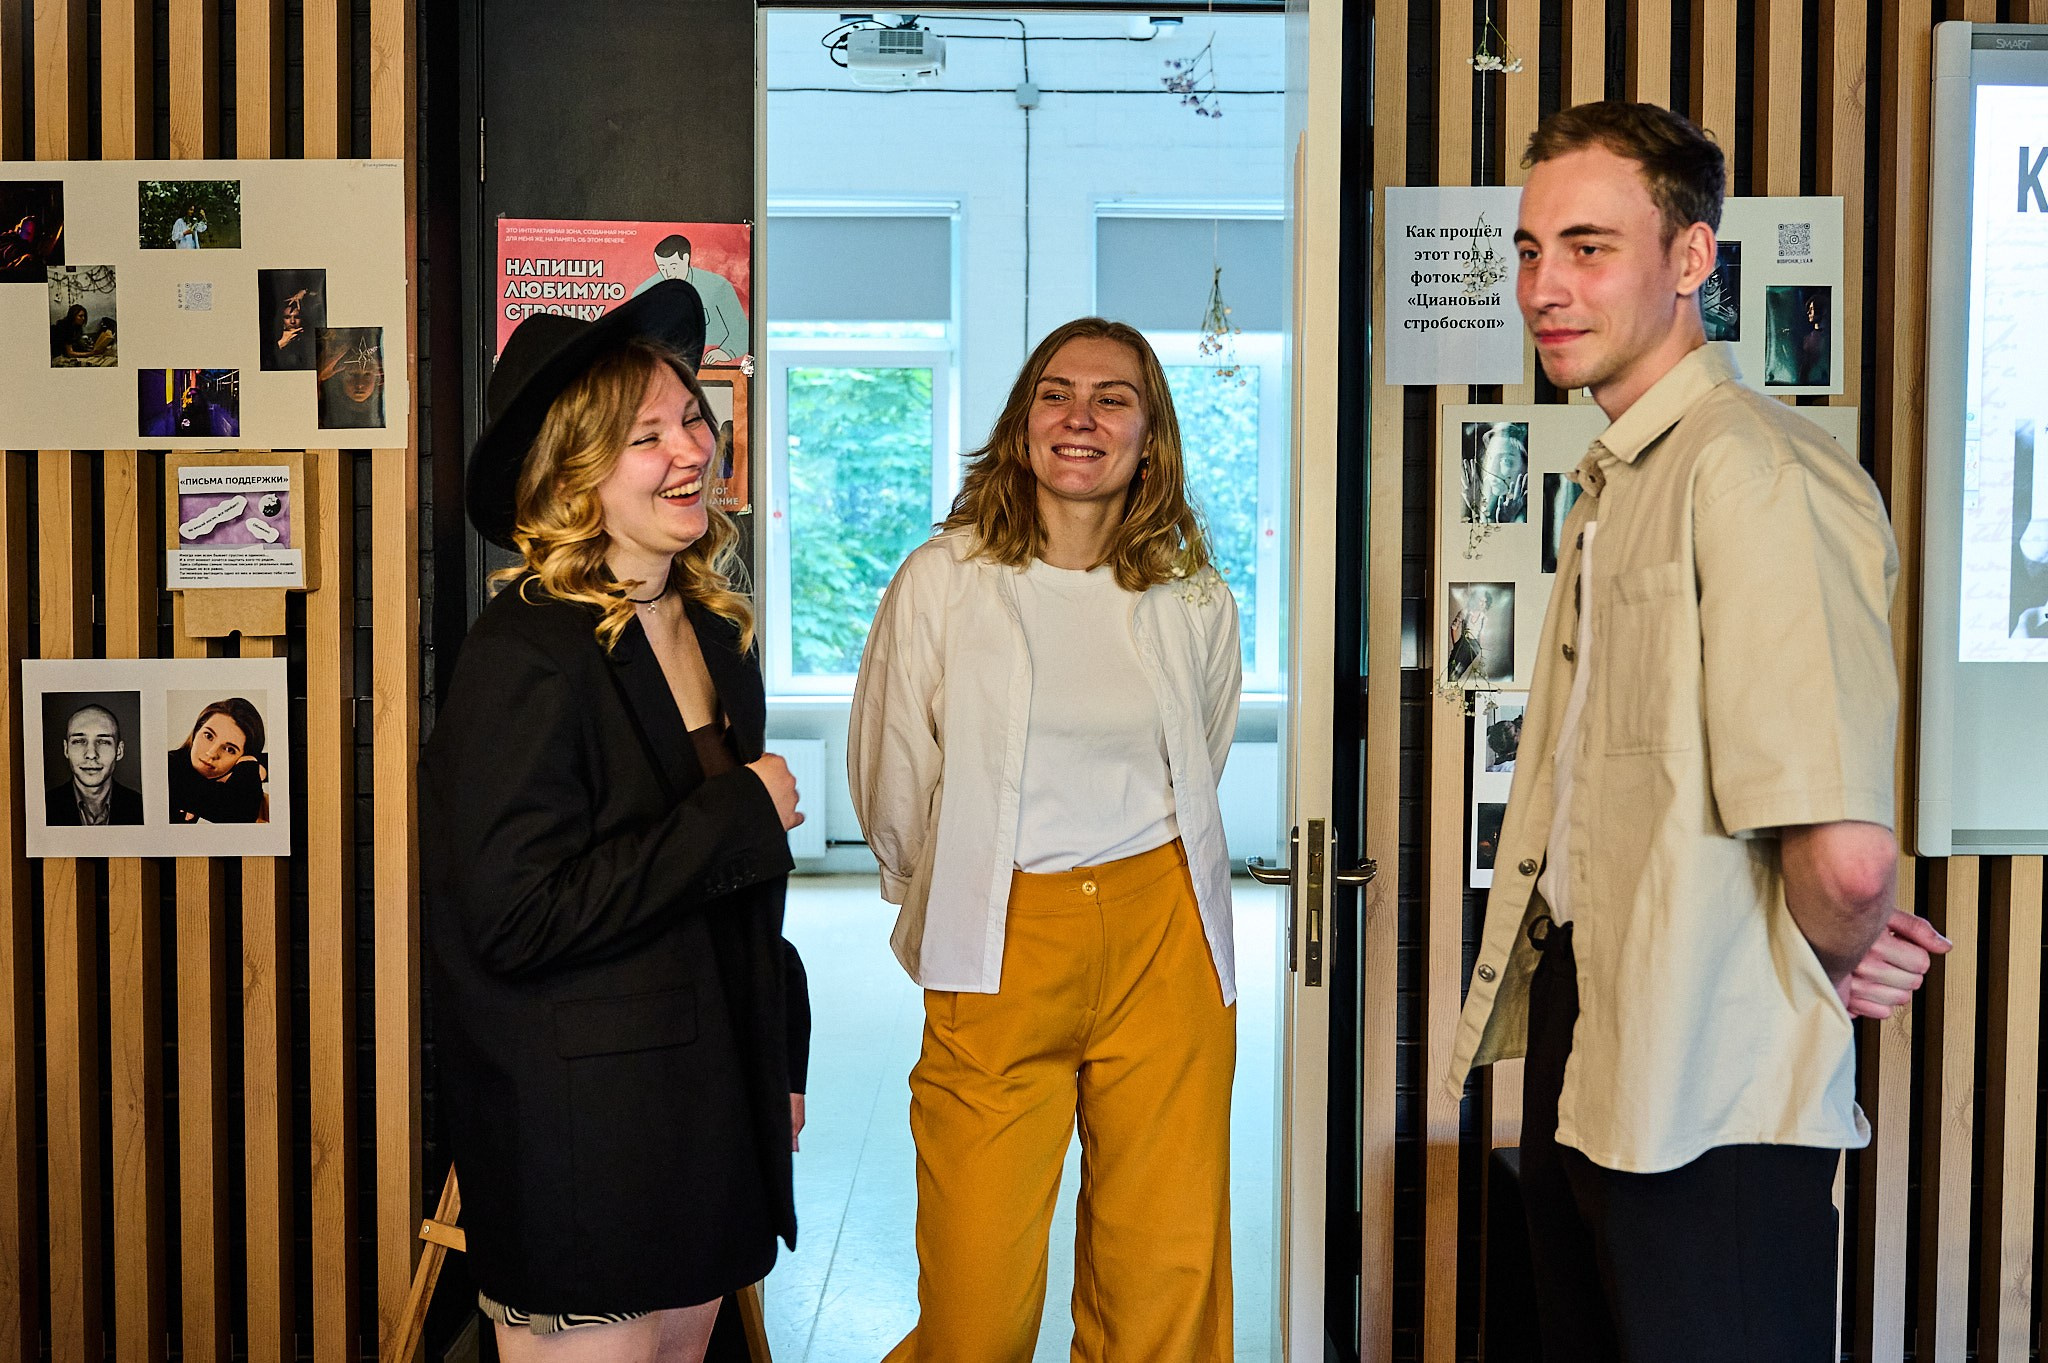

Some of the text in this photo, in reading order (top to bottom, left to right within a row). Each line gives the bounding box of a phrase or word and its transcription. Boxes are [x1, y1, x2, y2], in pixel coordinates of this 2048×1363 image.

[1996, 39, 2031, 49] SMART
[1406, 224, 1503, 241] Как прошёл
[1414, 250, 1495, 263] этот год в
[505, 258, 604, 277] НАПИШИ
[504, 280, 626, 300] ЛЮБИМУЮ
[1404, 315, 1505, 332] стробоскоп»
[180, 476, 289, 486] «ПИСЬМА ПОДДЕРЖКИ»
